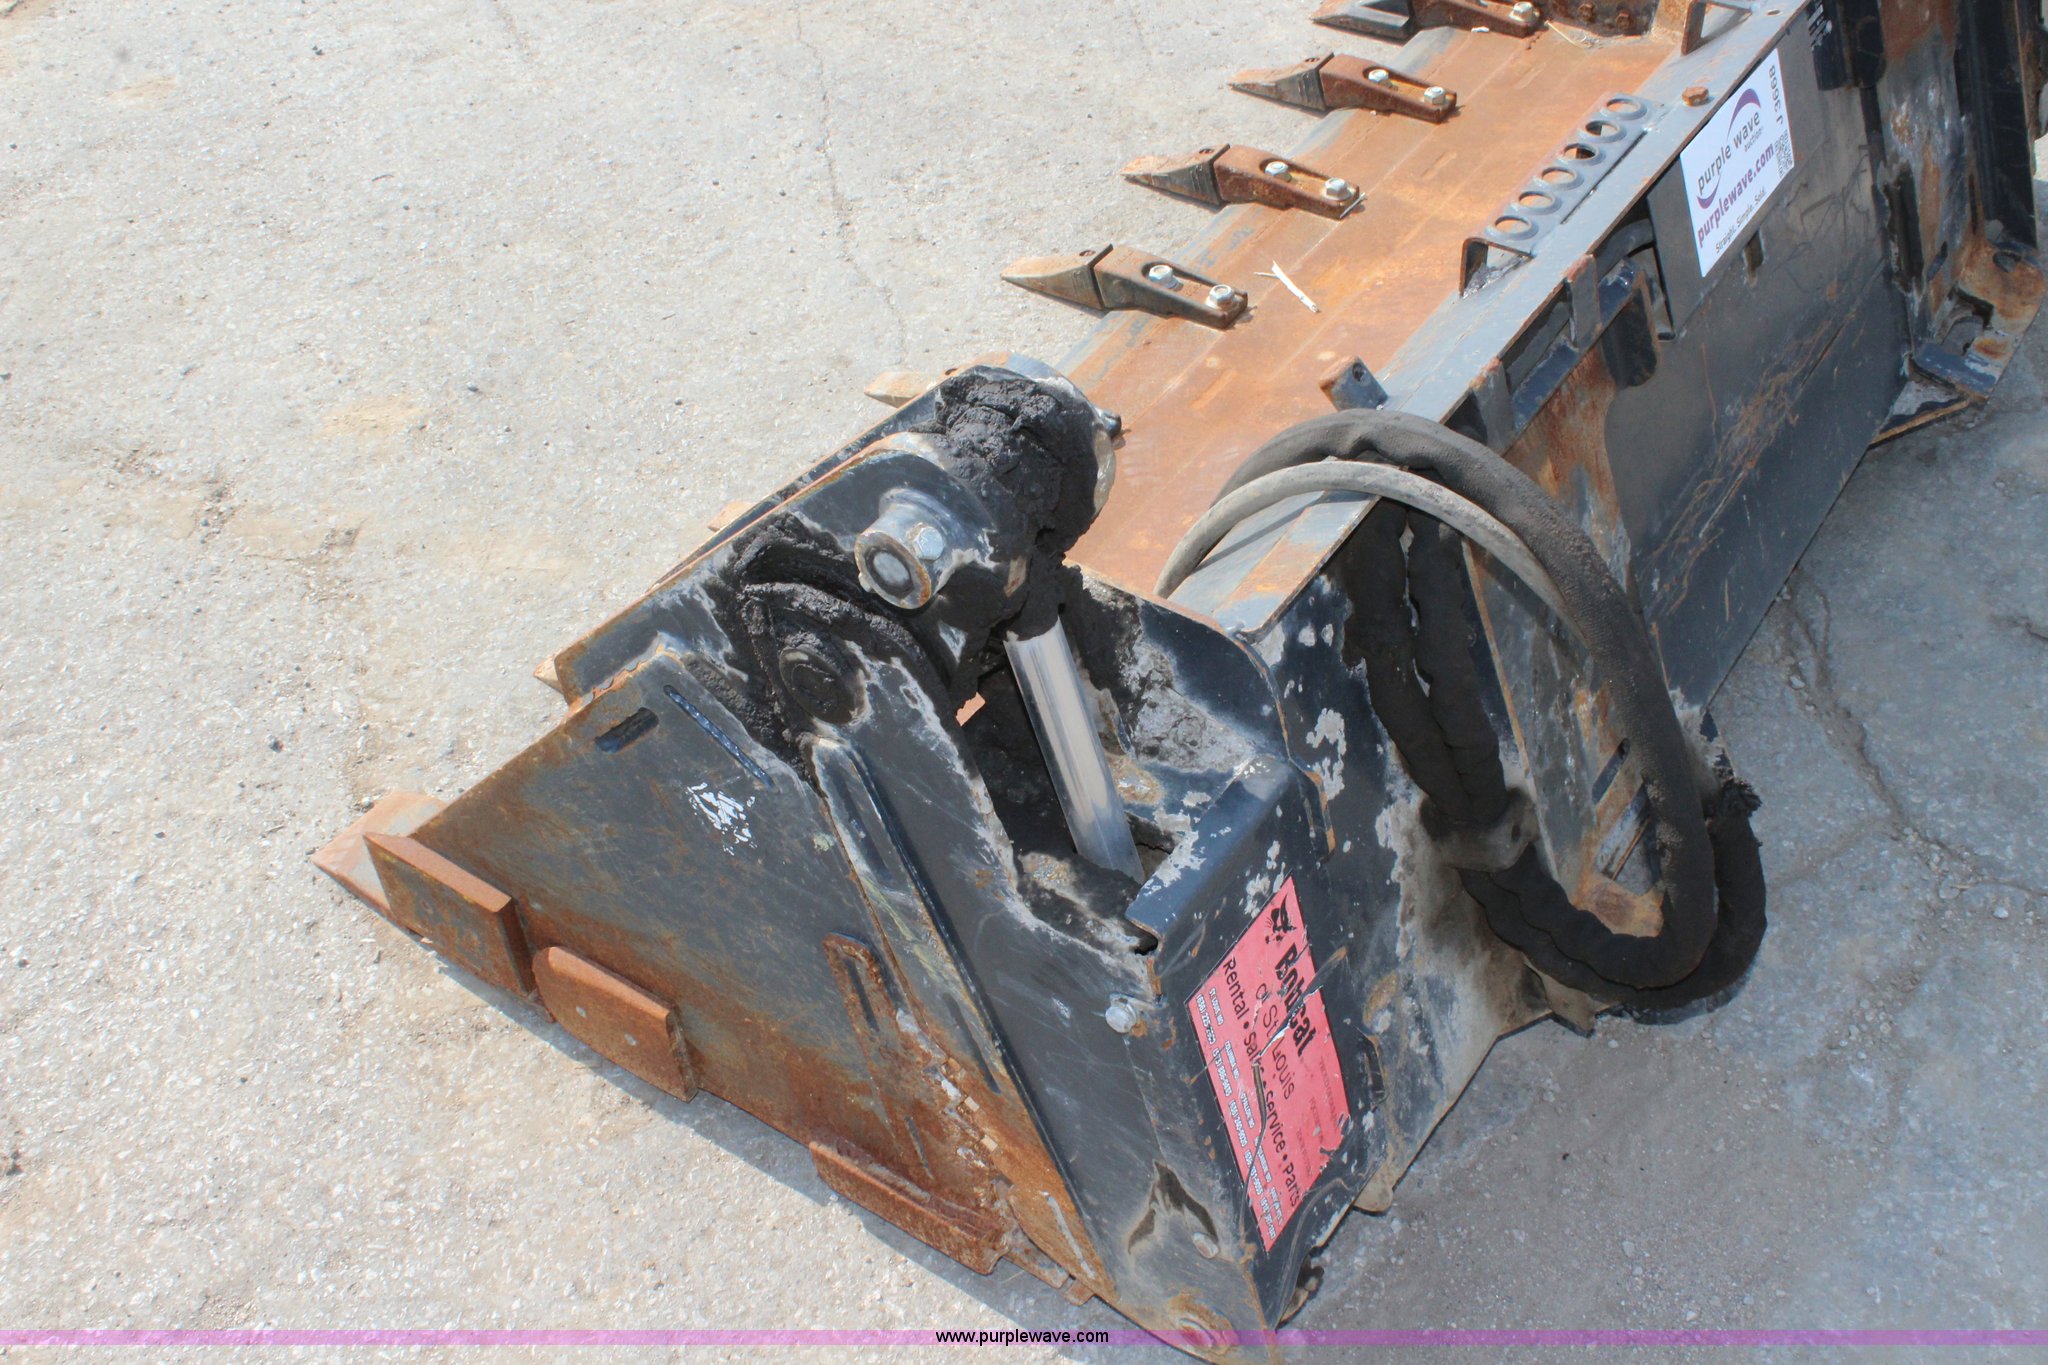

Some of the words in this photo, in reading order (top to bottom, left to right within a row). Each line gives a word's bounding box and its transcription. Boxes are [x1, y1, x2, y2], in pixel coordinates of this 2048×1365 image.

[1769, 64, 1781, 112] 3668
[1697, 145, 1732, 193] purple
[1733, 111, 1761, 151] wave
[1697, 143, 1774, 248] purplewave.com
[1715, 225, 1737, 254] Straight.
[1736, 204, 1755, 228] Simple.
[1275, 943, 1314, 1056] Bobcat
[1223, 956, 1249, 1021] Rental
[1265, 1092, 1286, 1153] Service
[1283, 1162, 1301, 1207] Parts
[1271, 1036, 1295, 1100] Louis
